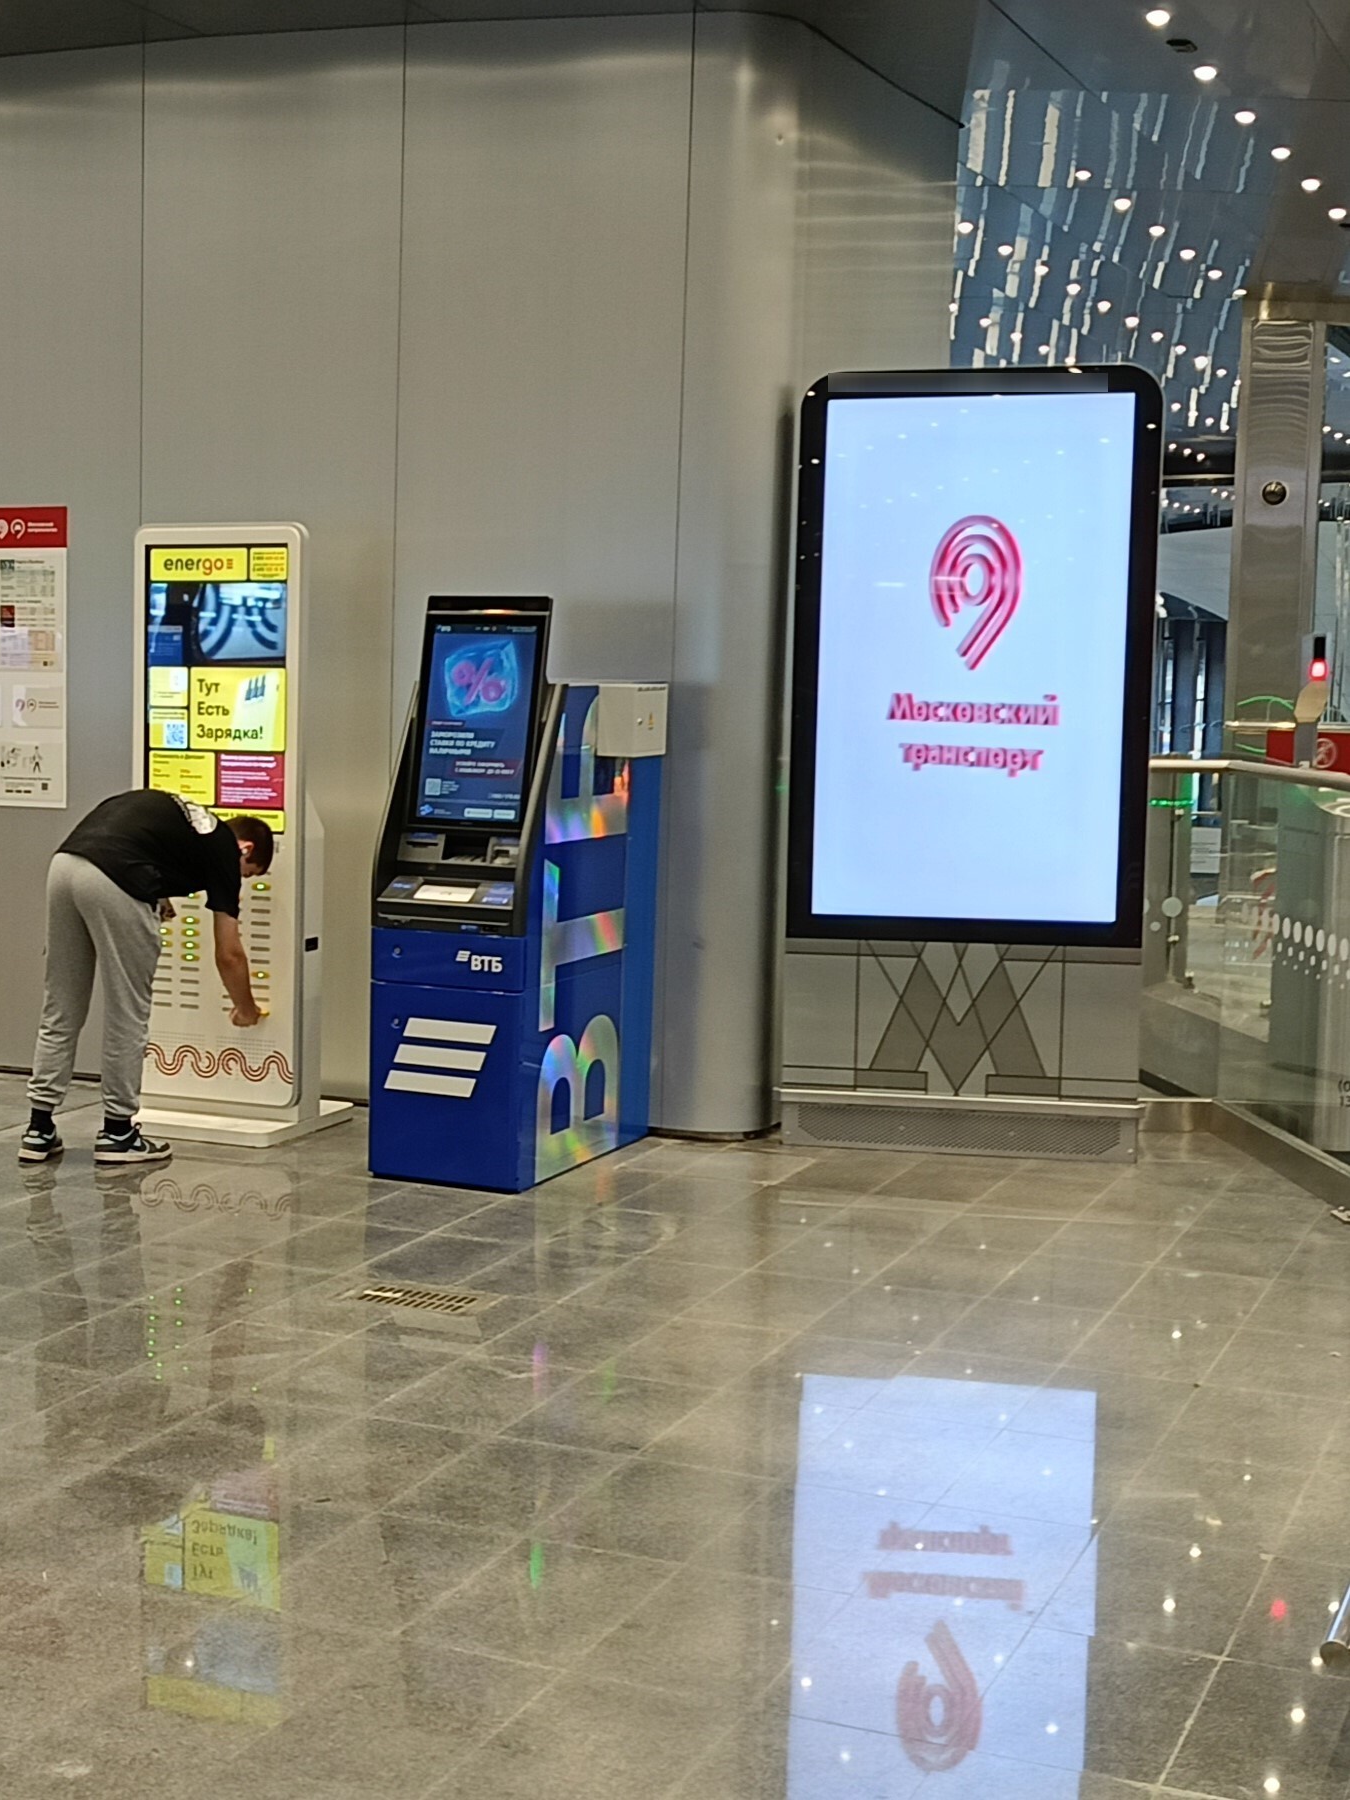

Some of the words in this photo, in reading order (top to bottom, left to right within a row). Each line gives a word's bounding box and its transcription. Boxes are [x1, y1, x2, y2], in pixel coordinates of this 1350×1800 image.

[163, 558, 224, 576] energo
[197, 678, 220, 697] Тут
[197, 701, 230, 716] Есть
[886, 693, 1060, 726] Московский
[196, 724, 263, 742] Зарядка!
[899, 743, 1045, 778] транспорт
[471, 955, 503, 972] ВТБ
